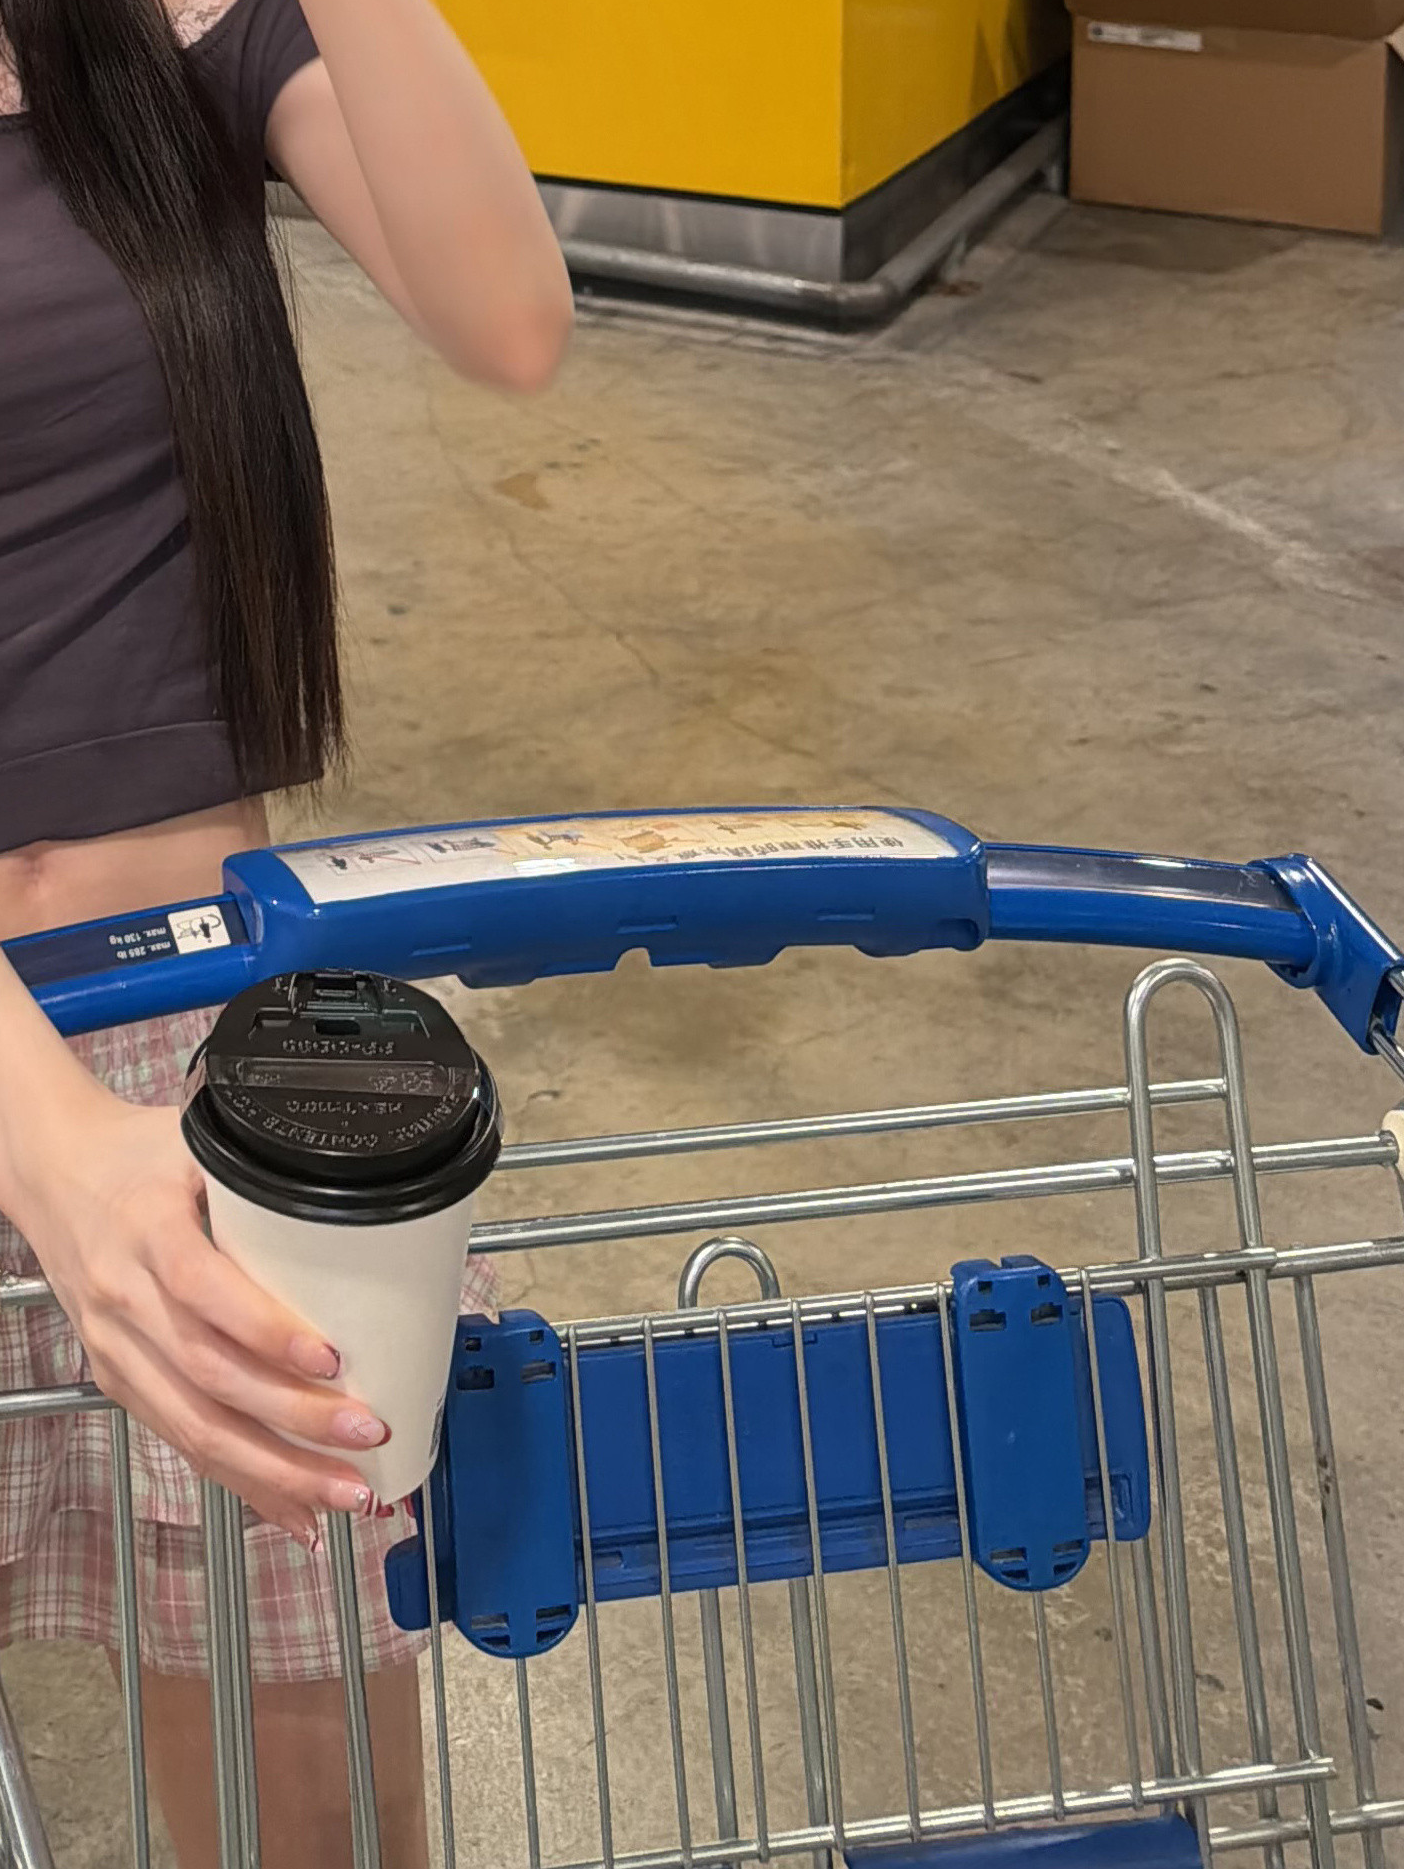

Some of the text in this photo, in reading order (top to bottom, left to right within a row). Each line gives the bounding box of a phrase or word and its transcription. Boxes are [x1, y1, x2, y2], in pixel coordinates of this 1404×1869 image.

[143, 927, 166, 937] max.
[108, 934, 124, 946] kg
[147, 941, 171, 951] max.
